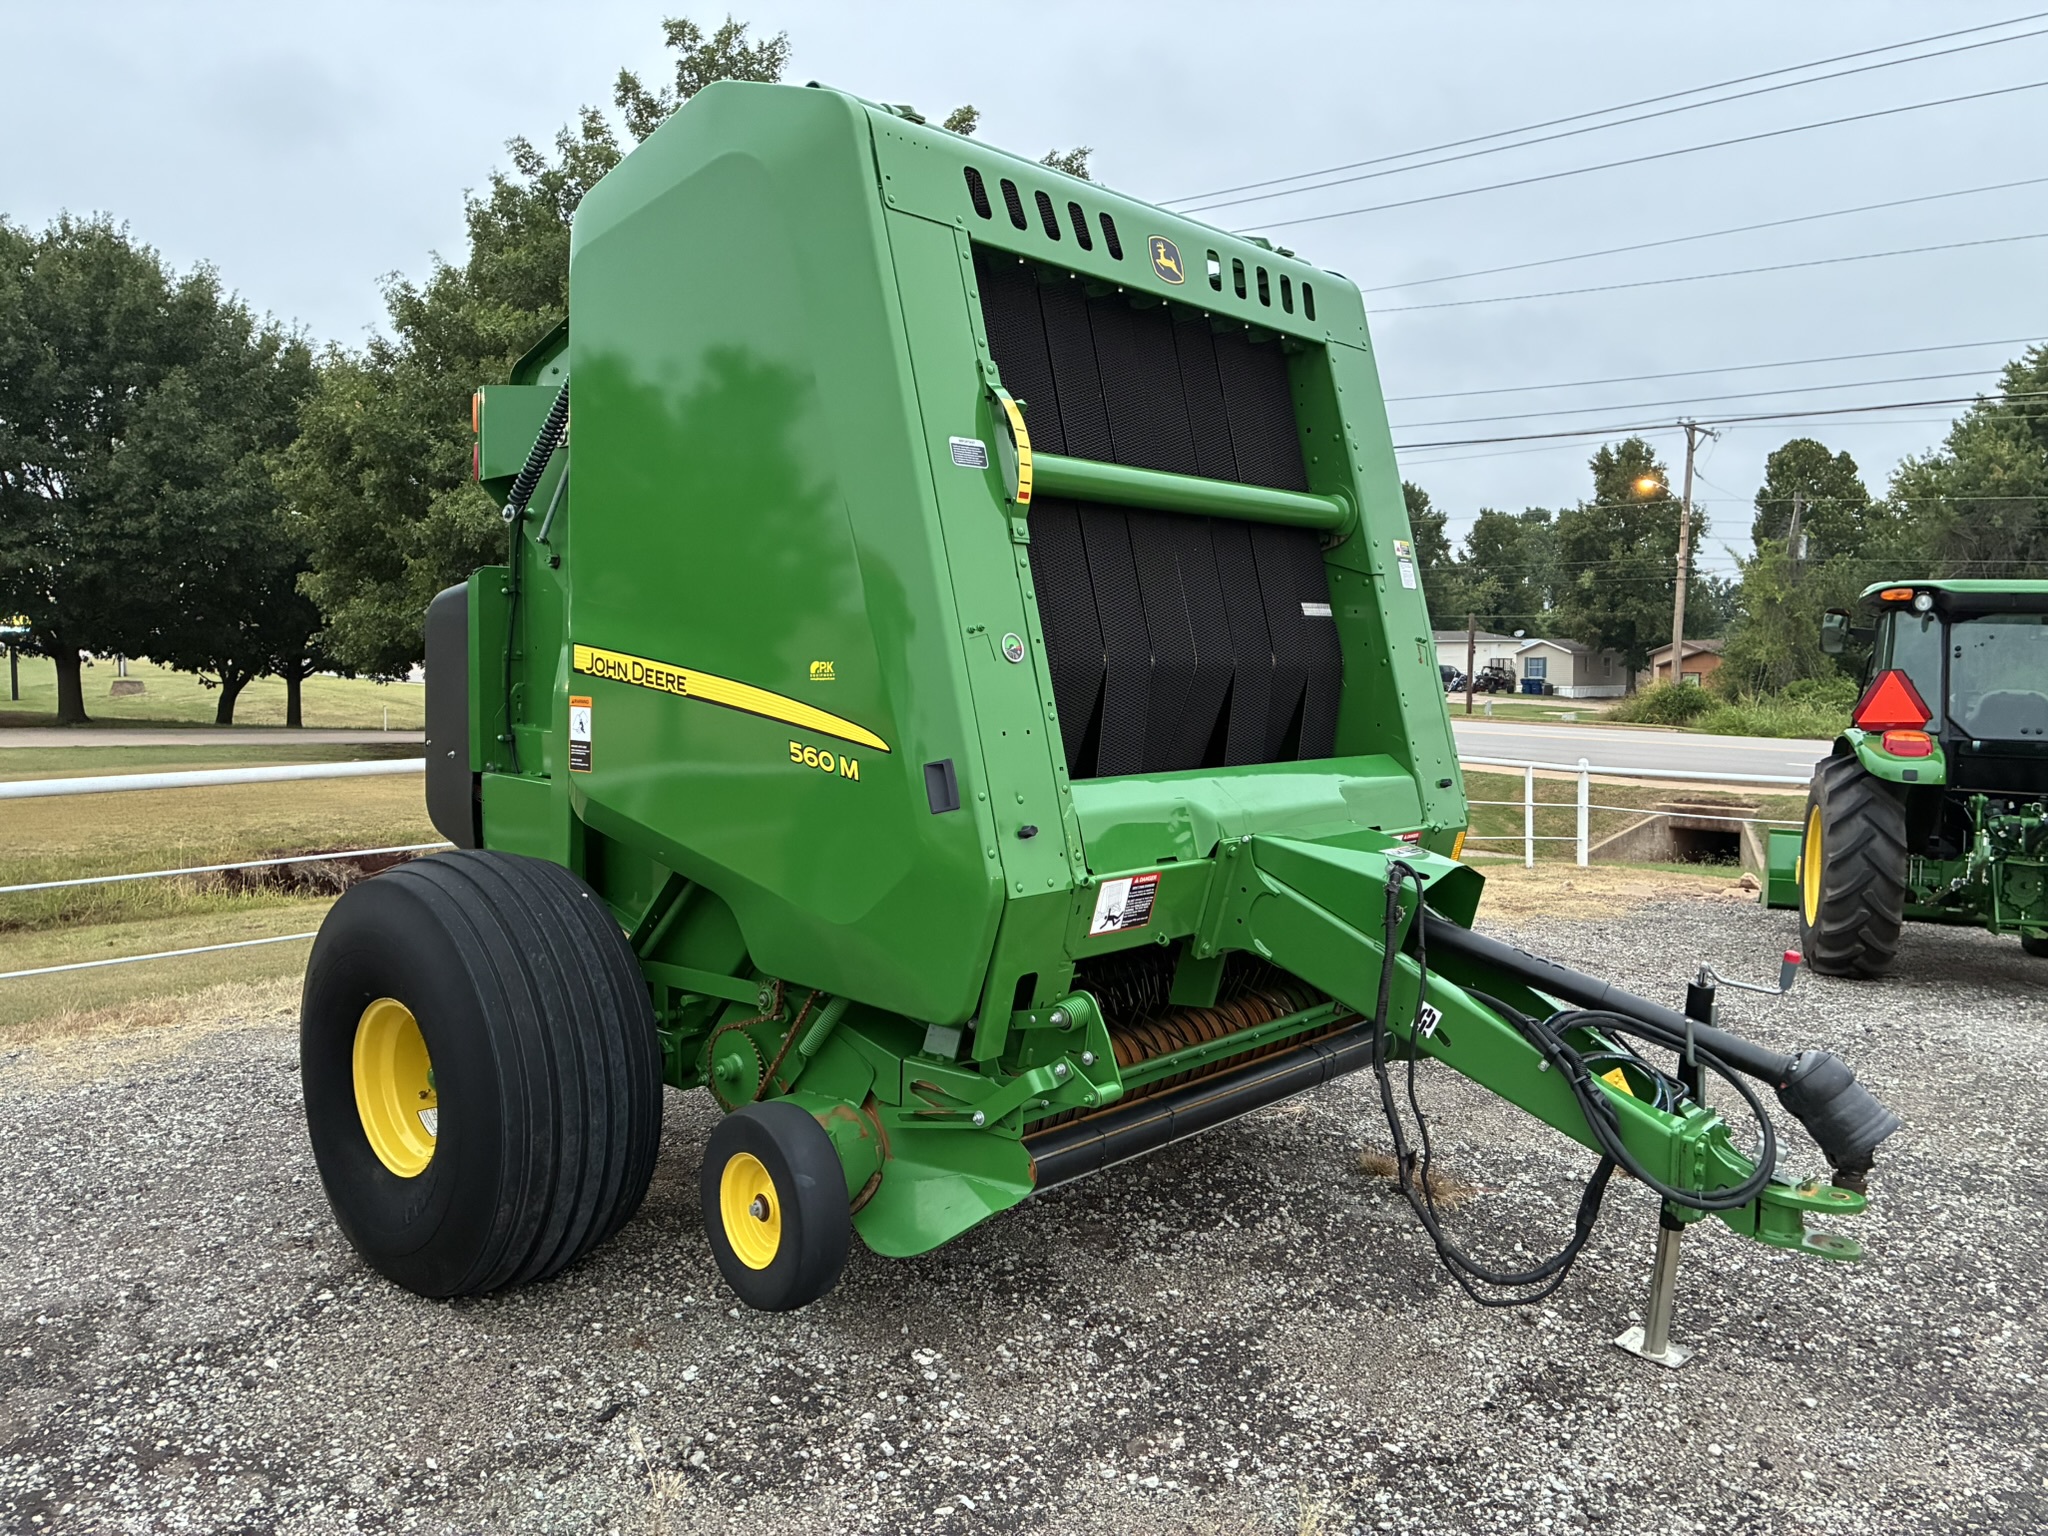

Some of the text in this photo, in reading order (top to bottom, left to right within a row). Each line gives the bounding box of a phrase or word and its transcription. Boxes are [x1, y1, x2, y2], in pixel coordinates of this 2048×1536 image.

[586, 653, 687, 693] JOHN DEERE
[789, 740, 860, 782] 560 M
